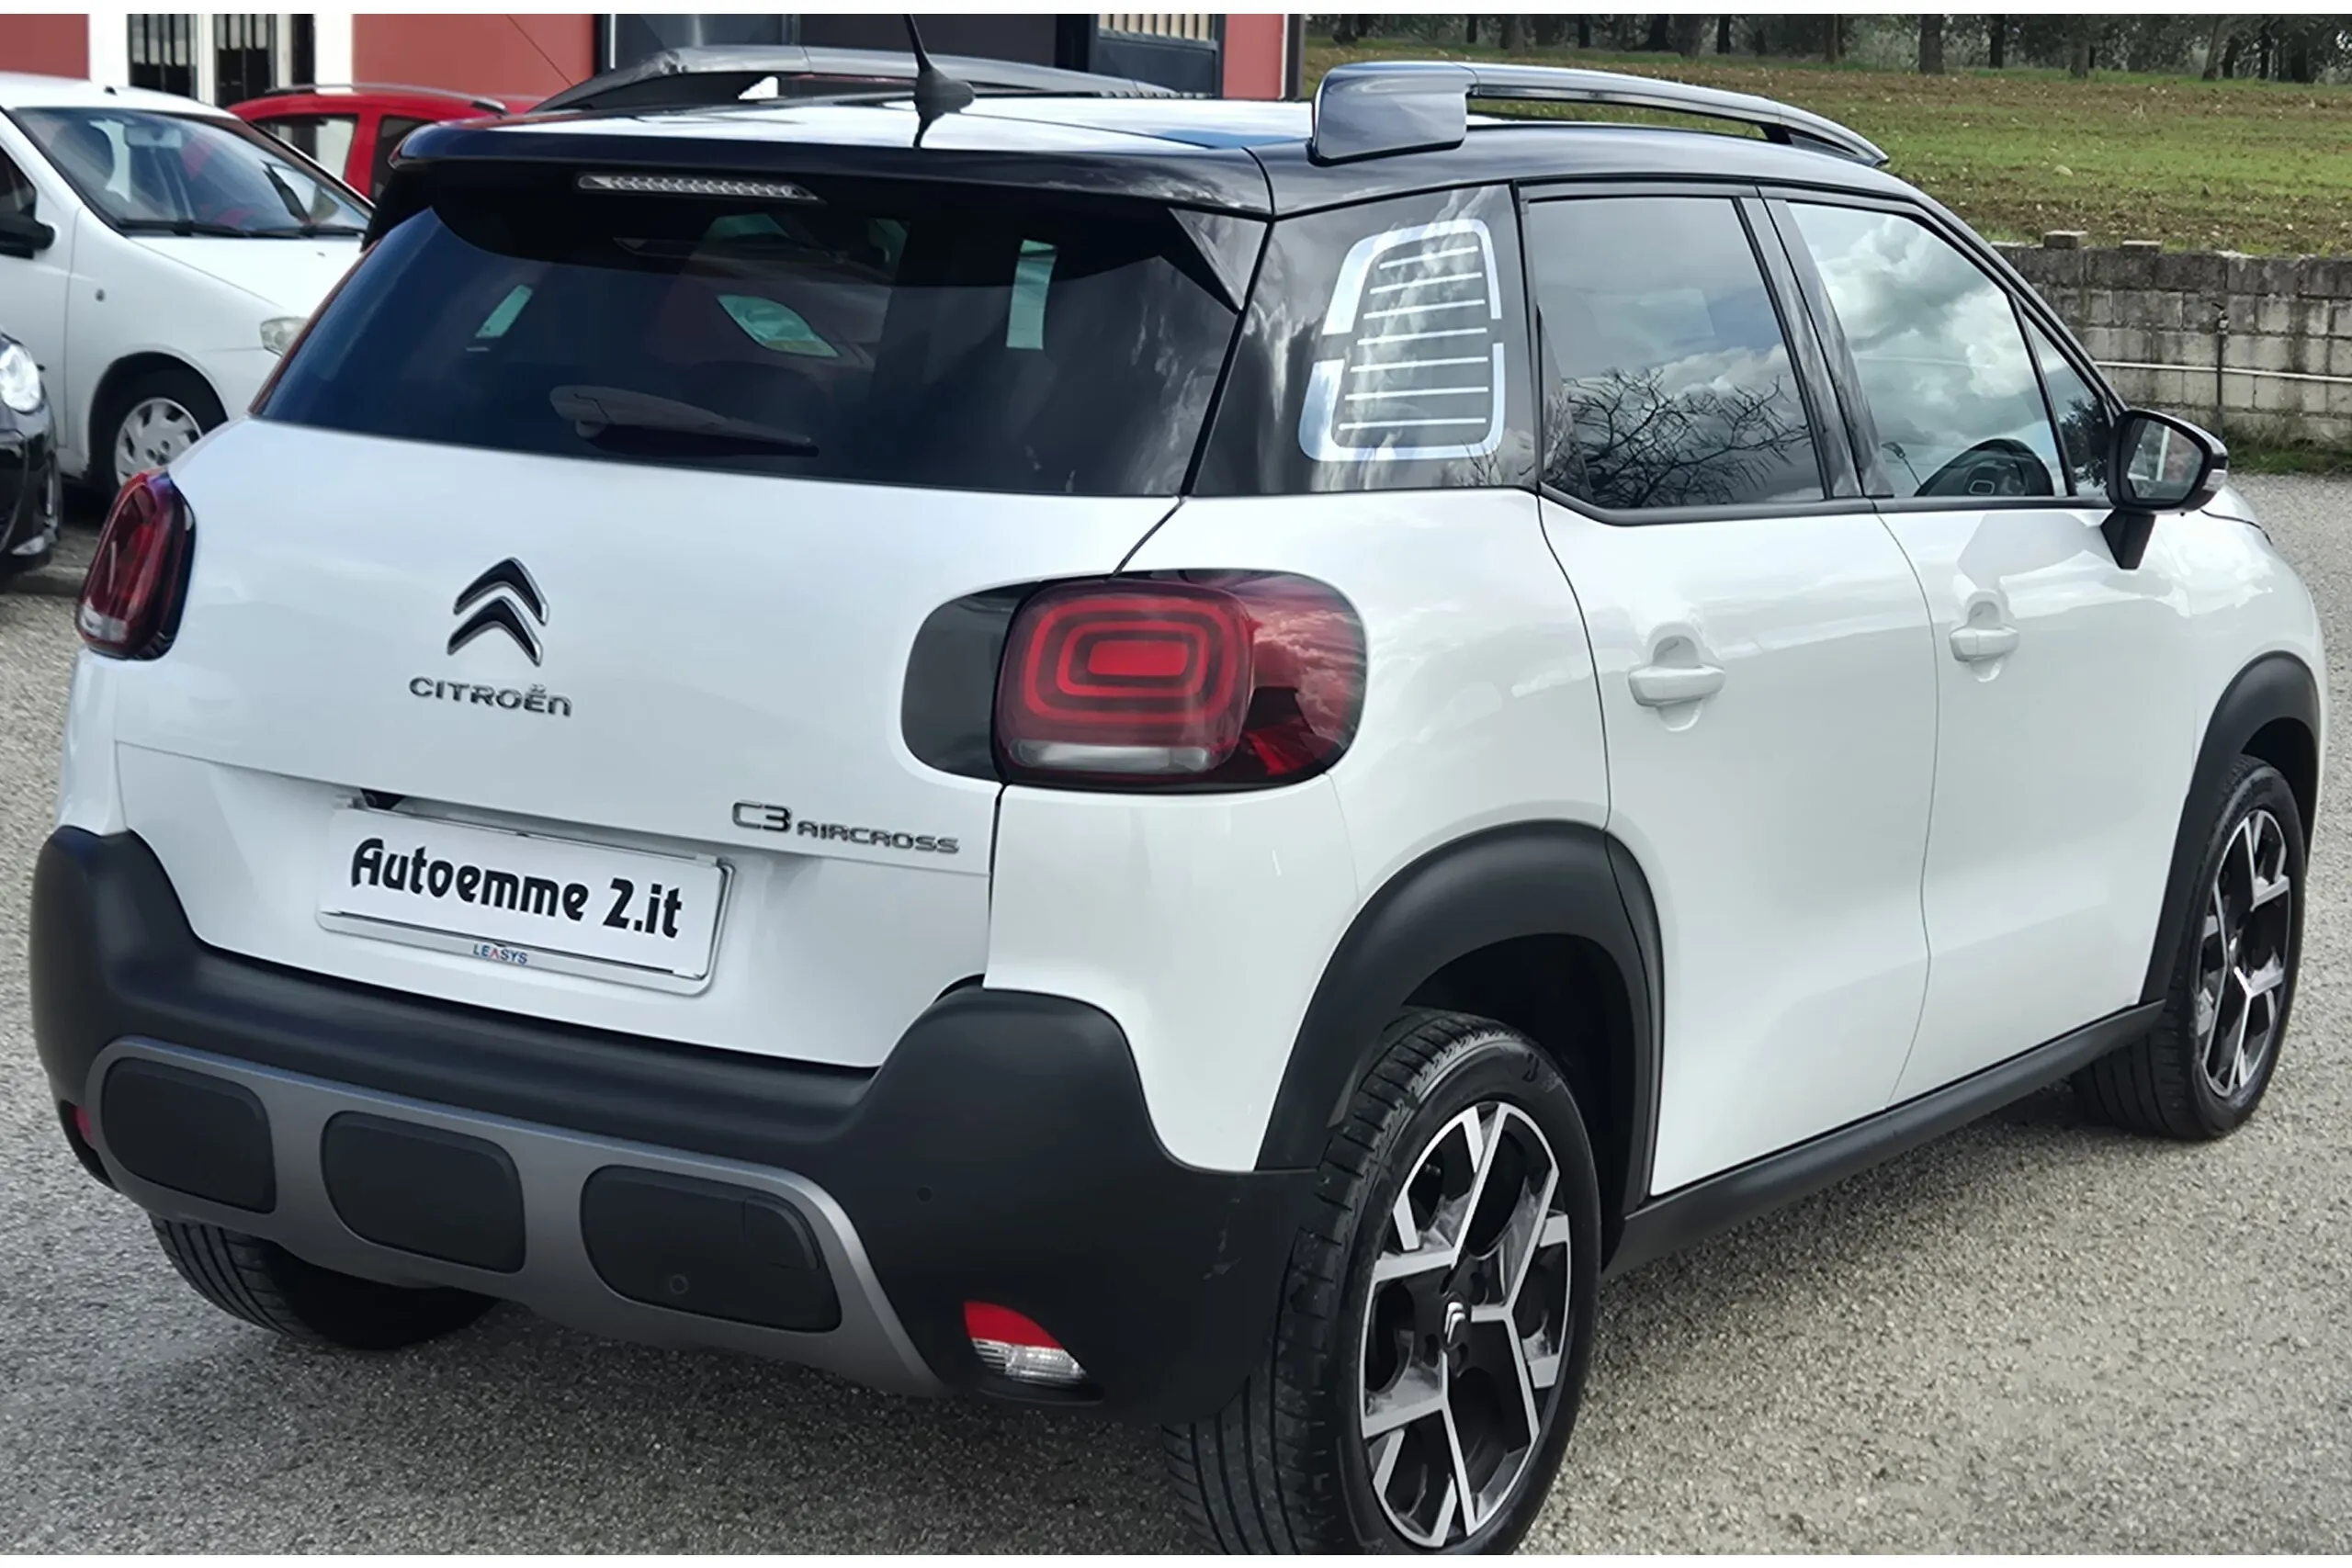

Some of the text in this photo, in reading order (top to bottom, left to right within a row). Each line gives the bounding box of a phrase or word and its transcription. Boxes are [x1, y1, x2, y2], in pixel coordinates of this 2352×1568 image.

[732, 800, 960, 854] C3 AIRCROSS
[351, 838, 683, 939] Autoemme 2.it
[473, 943, 528, 964] LEASYS
